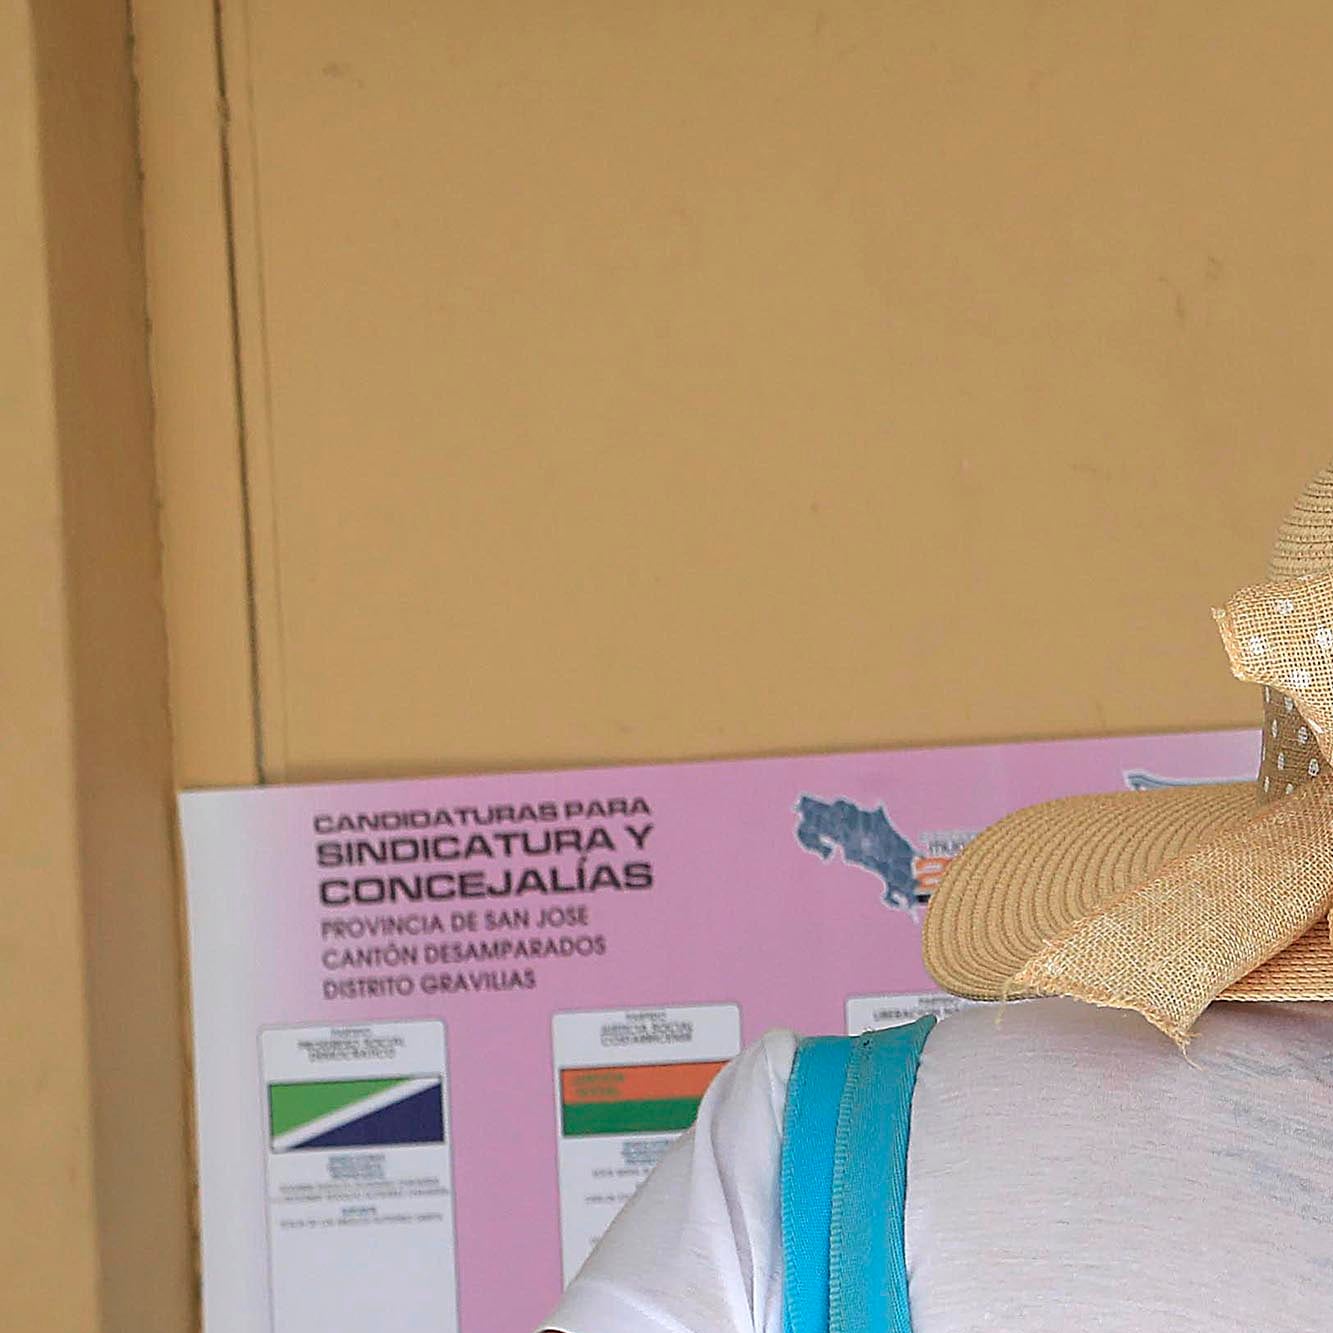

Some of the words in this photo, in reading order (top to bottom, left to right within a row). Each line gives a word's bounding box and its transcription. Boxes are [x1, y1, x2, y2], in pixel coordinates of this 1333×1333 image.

[312, 801, 559, 834] CANDIDATURAS
[563, 797, 651, 821] PARA
[317, 826, 616, 869] SINDICATURA
[624, 823, 654, 849] Y
[319, 855, 654, 907] CONCEJALÍAS
[320, 911, 445, 941] PROVINCIA
[451, 910, 478, 933] DE
[484, 907, 530, 932] SAN
[537, 904, 590, 929] JOSE
[321, 943, 418, 971] CANTÓN
[423, 934, 607, 965] DESAMPARADOS
[322, 974, 415, 1001] DISTRITO
[420, 967, 537, 995] GRAVILIAS
